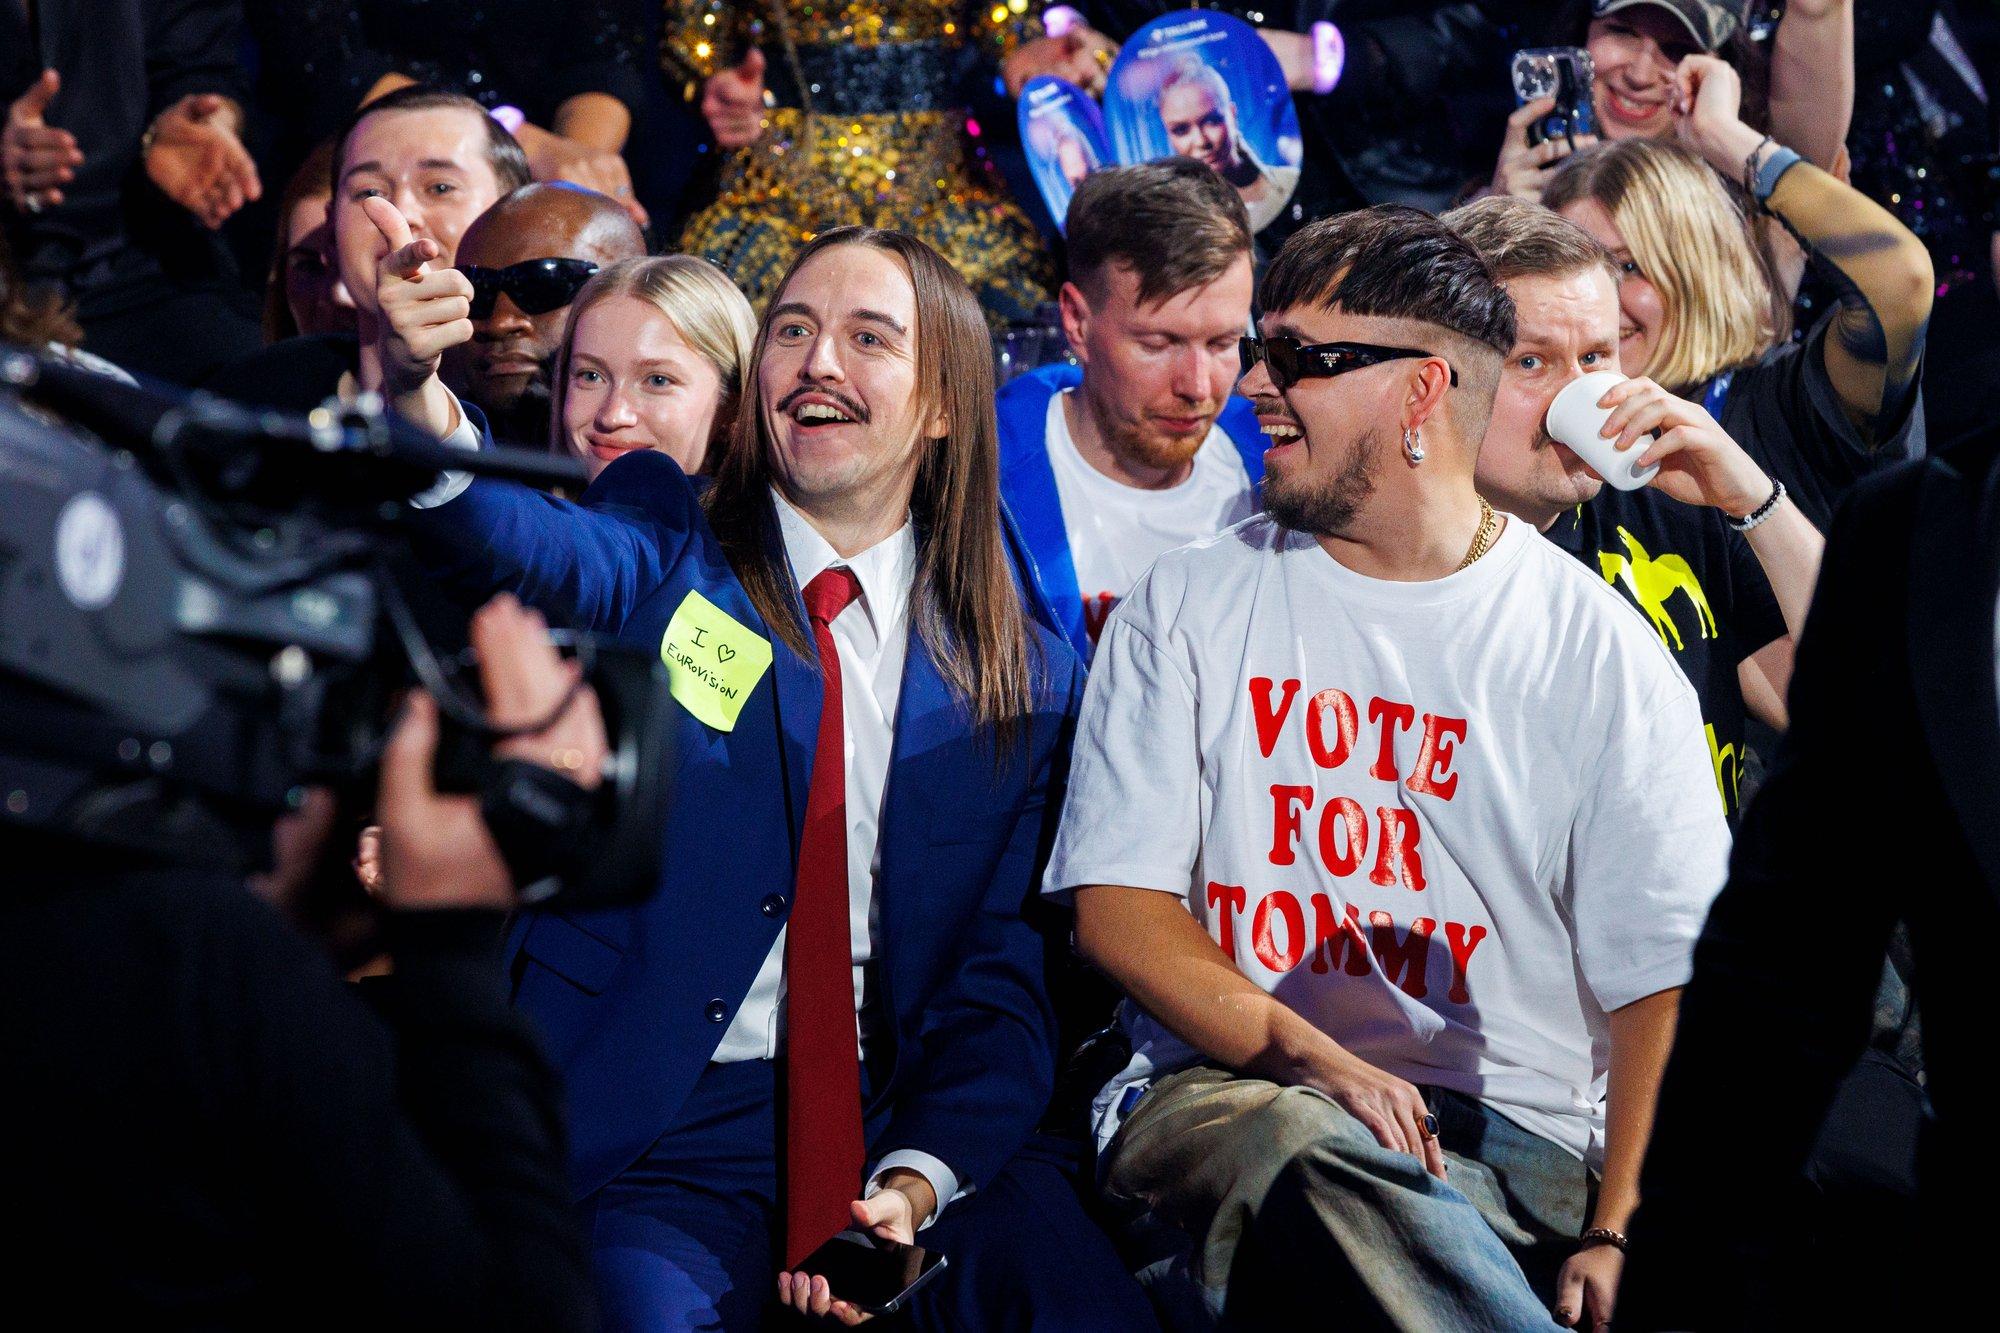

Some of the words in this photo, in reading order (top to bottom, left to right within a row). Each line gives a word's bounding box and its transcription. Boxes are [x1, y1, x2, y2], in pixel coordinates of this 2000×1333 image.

[691, 626, 709, 648] I
[1248, 676, 1467, 802] VOTE
[1268, 784, 1428, 892] FOR
[1207, 880, 1488, 1005] TOMMY
